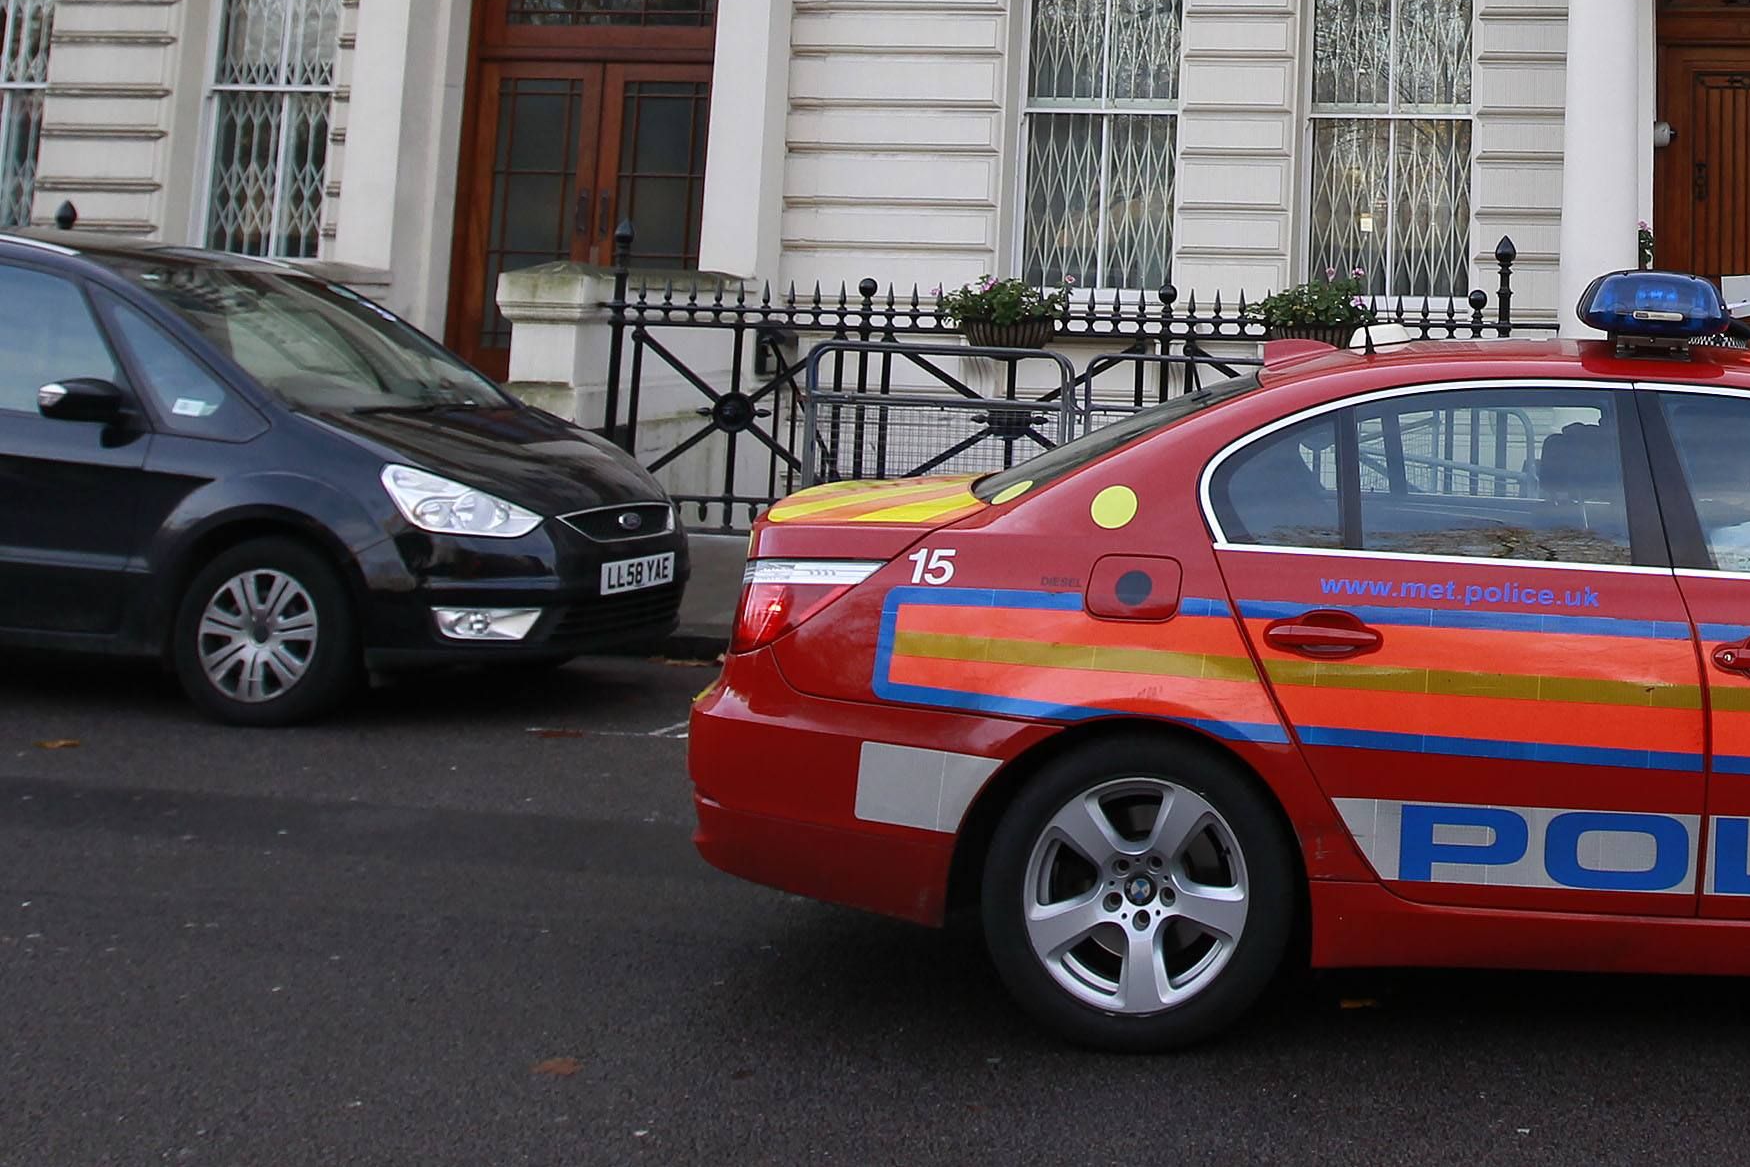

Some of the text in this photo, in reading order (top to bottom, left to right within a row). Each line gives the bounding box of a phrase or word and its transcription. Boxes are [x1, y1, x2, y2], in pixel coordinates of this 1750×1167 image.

[607, 556, 670, 590] LL58 YAE
[908, 548, 957, 585] 15
[1320, 577, 1600, 608] www.met.police.uk
